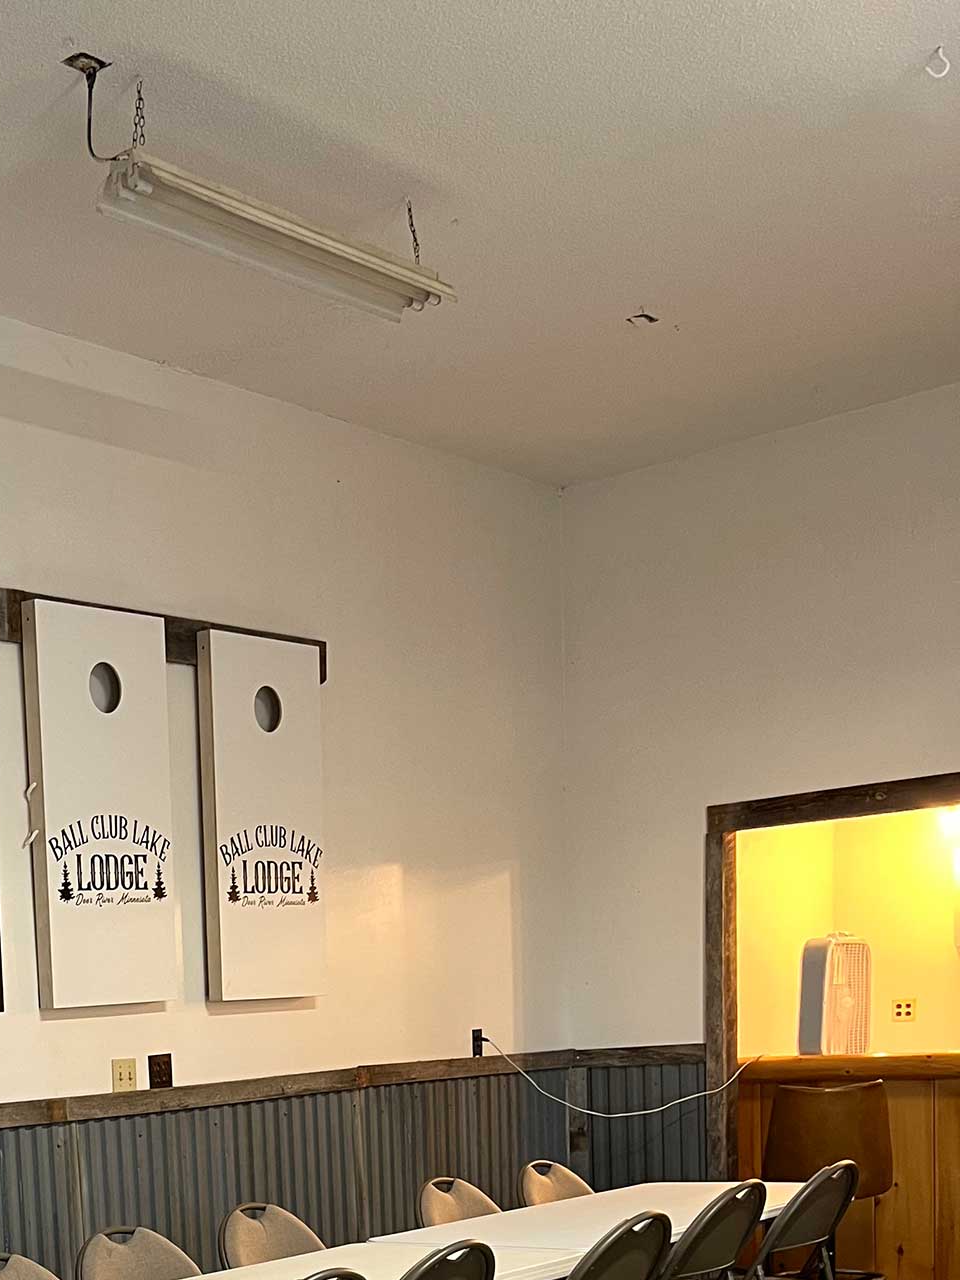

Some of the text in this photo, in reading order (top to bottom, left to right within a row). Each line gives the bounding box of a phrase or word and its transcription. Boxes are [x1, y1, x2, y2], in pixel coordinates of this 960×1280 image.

[48, 814, 171, 862] BALL CLUB LAKE
[219, 824, 323, 869] BALL CLUB LAKE
[75, 853, 149, 892] LODGE
[242, 859, 304, 895] LODGE
